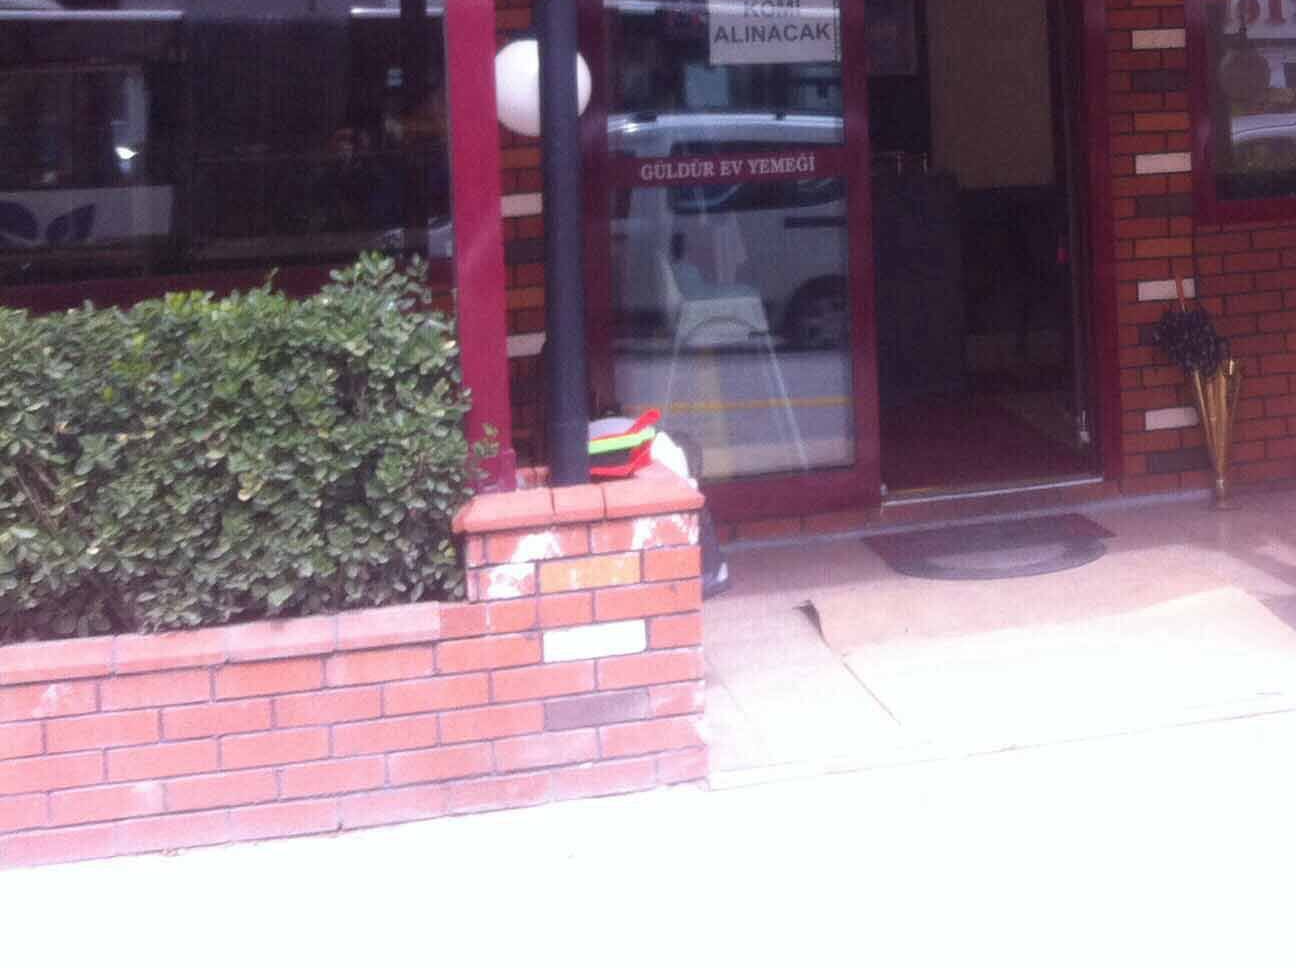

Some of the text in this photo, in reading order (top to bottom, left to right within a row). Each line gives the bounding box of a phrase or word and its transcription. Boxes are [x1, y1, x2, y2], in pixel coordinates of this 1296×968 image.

[713, 22, 832, 45] ALINACAK
[640, 152, 816, 181] GÜLDÜR EV YEMEĞİ
